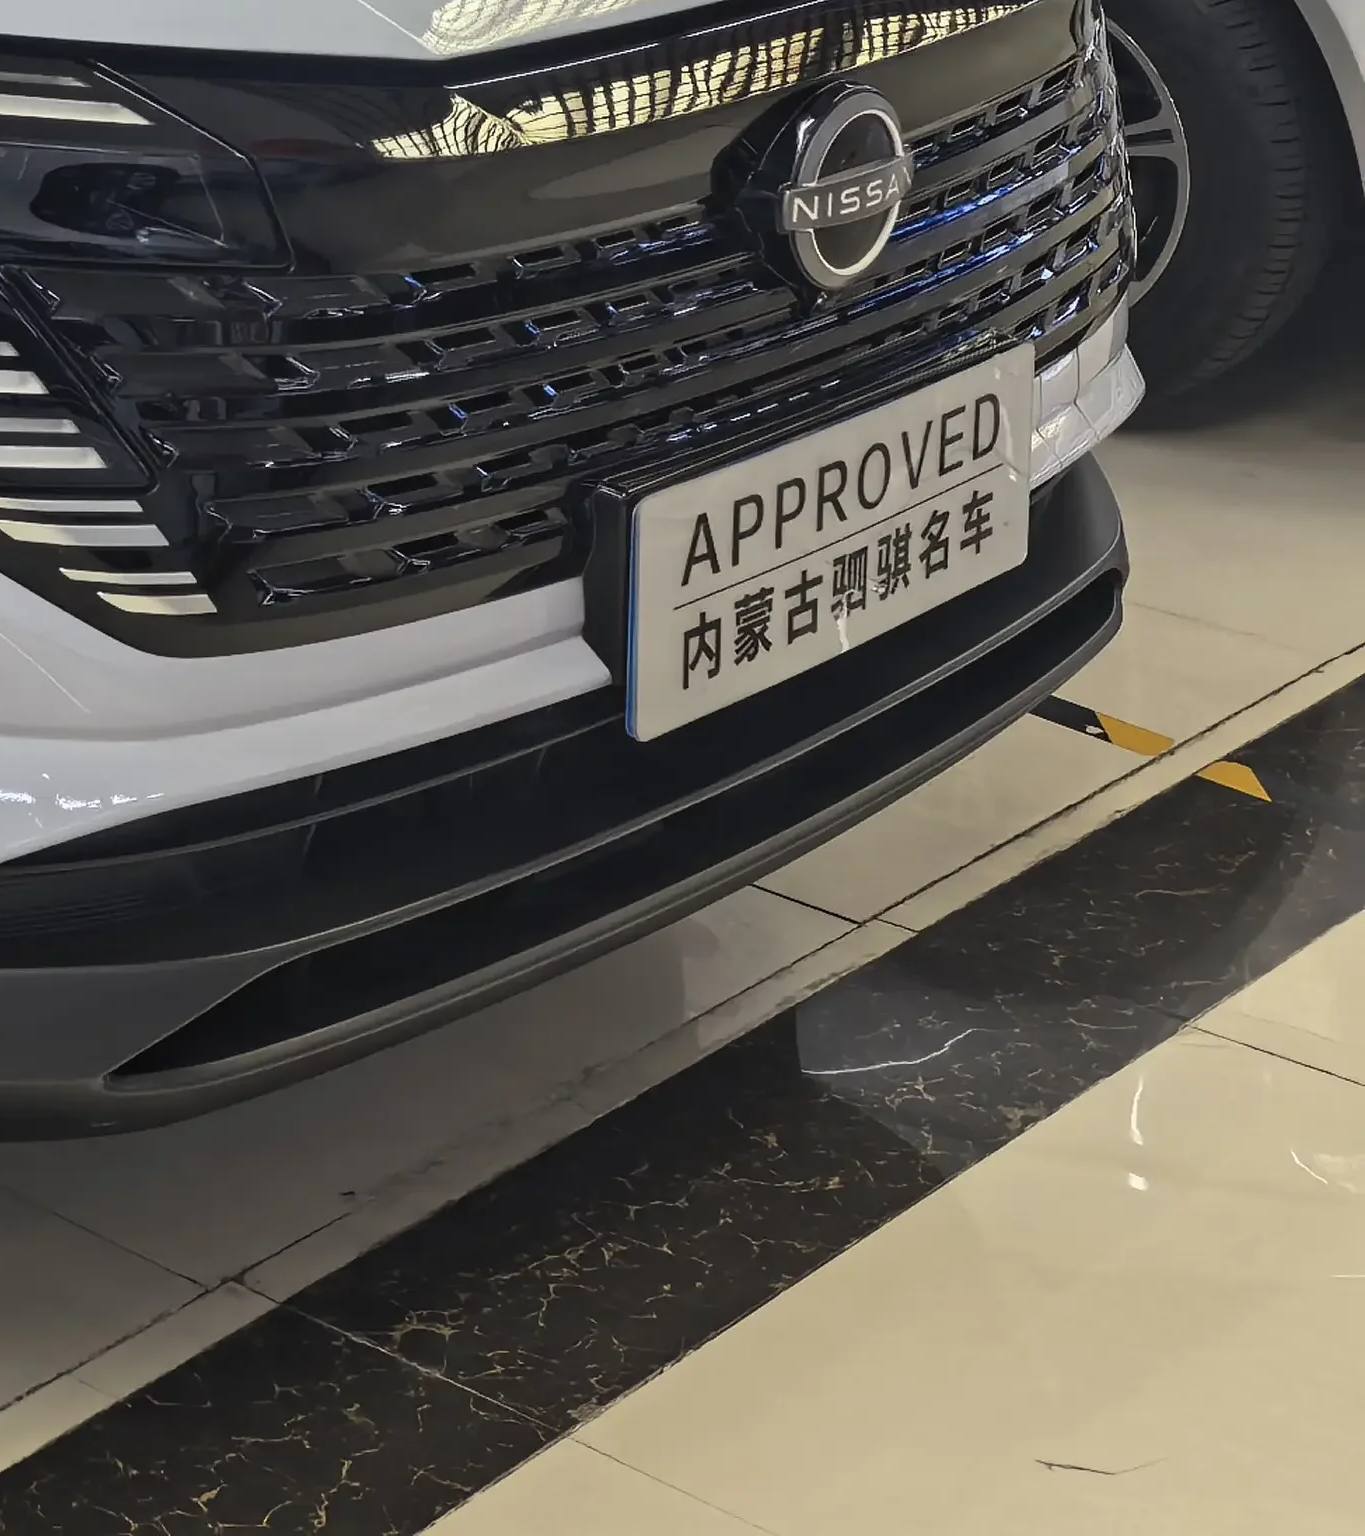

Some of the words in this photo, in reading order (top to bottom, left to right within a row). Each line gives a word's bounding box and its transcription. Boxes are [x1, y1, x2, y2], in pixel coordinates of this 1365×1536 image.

[681, 392, 1001, 587] APPROVED
[682, 490, 995, 691] 内蒙古驷骐名车
